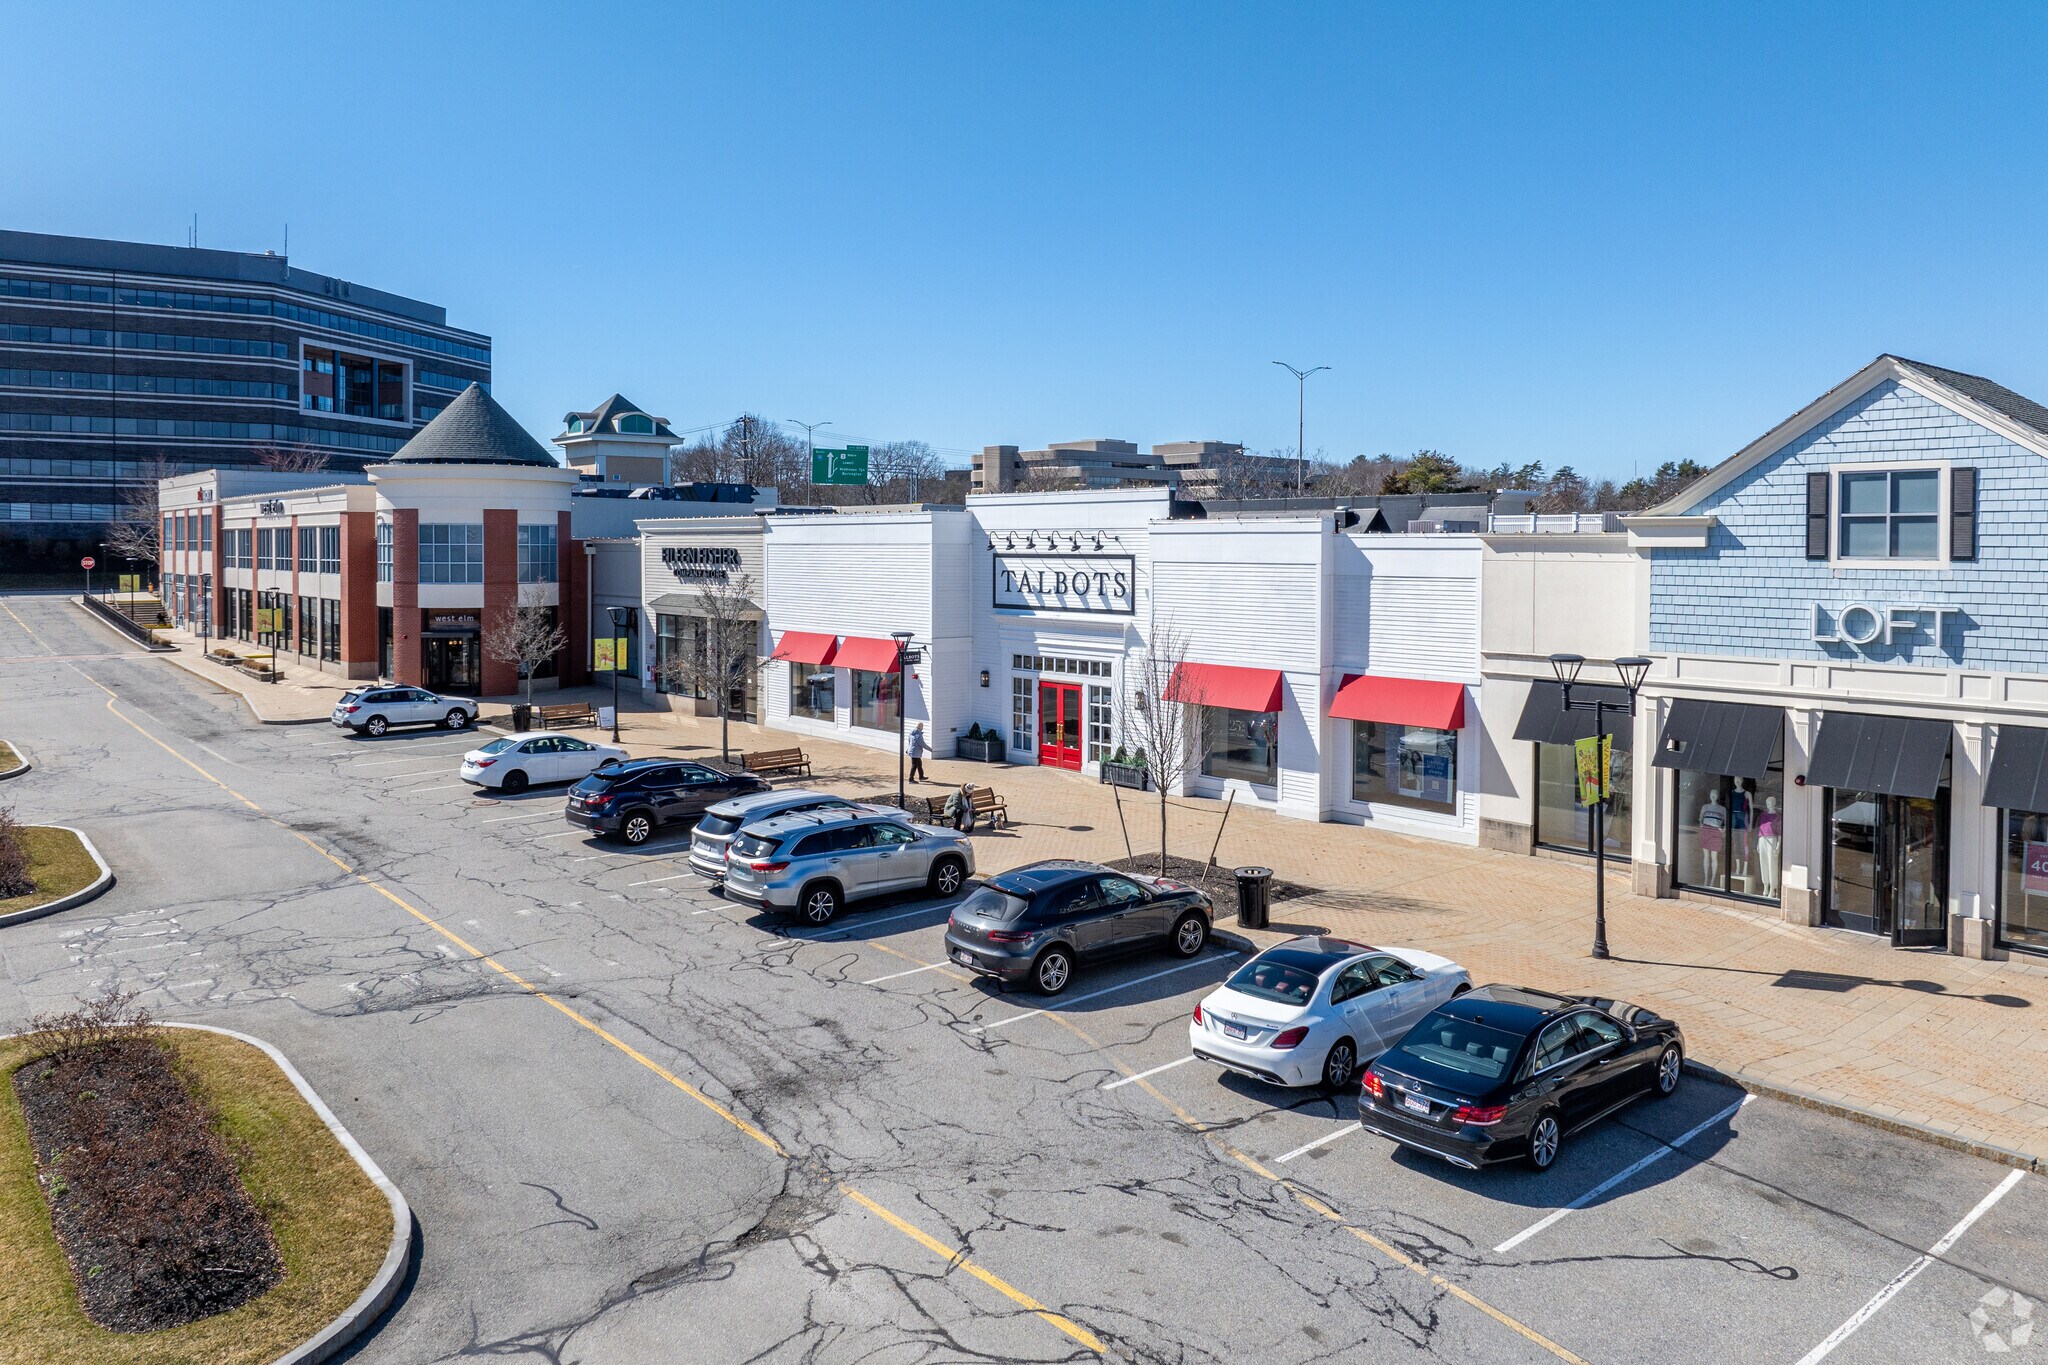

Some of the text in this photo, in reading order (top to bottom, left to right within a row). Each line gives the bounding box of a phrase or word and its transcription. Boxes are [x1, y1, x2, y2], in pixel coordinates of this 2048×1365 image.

[661, 547, 740, 565] EILEEN FISHER
[1000, 569, 1127, 598] TALBOTS
[434, 614, 475, 622] west elm
[1810, 602, 1961, 648] LOFT
